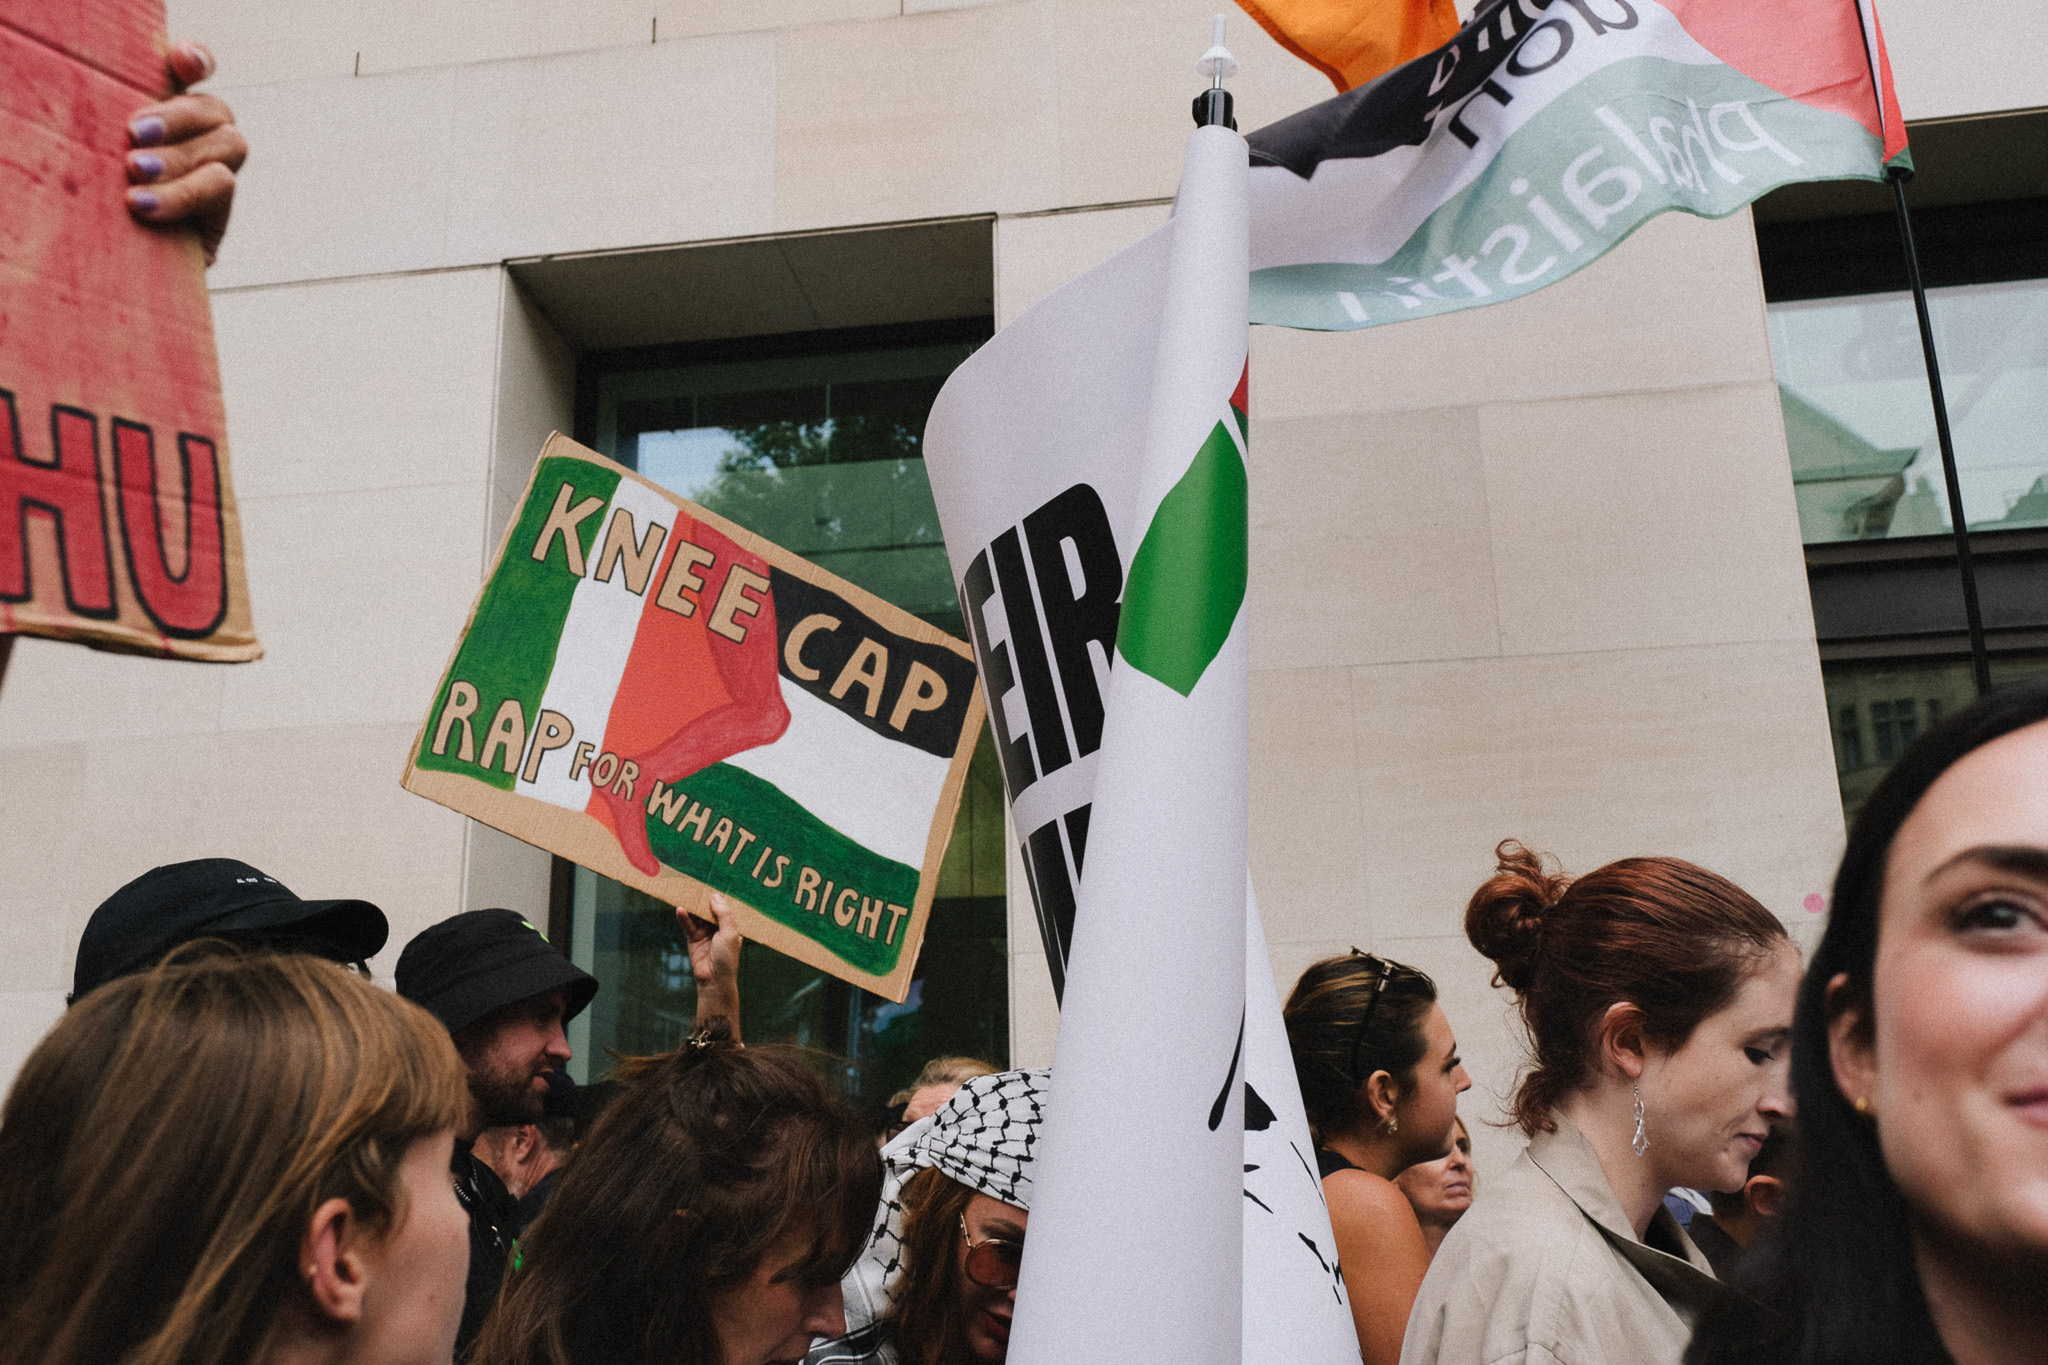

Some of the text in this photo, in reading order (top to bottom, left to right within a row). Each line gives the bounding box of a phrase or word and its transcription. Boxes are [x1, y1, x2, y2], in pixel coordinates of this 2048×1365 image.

[531, 482, 949, 732] KNEE CAP
[959, 483, 1122, 806] EIR
[431, 679, 909, 946] RAP FOR WHAT IS RIGHT
